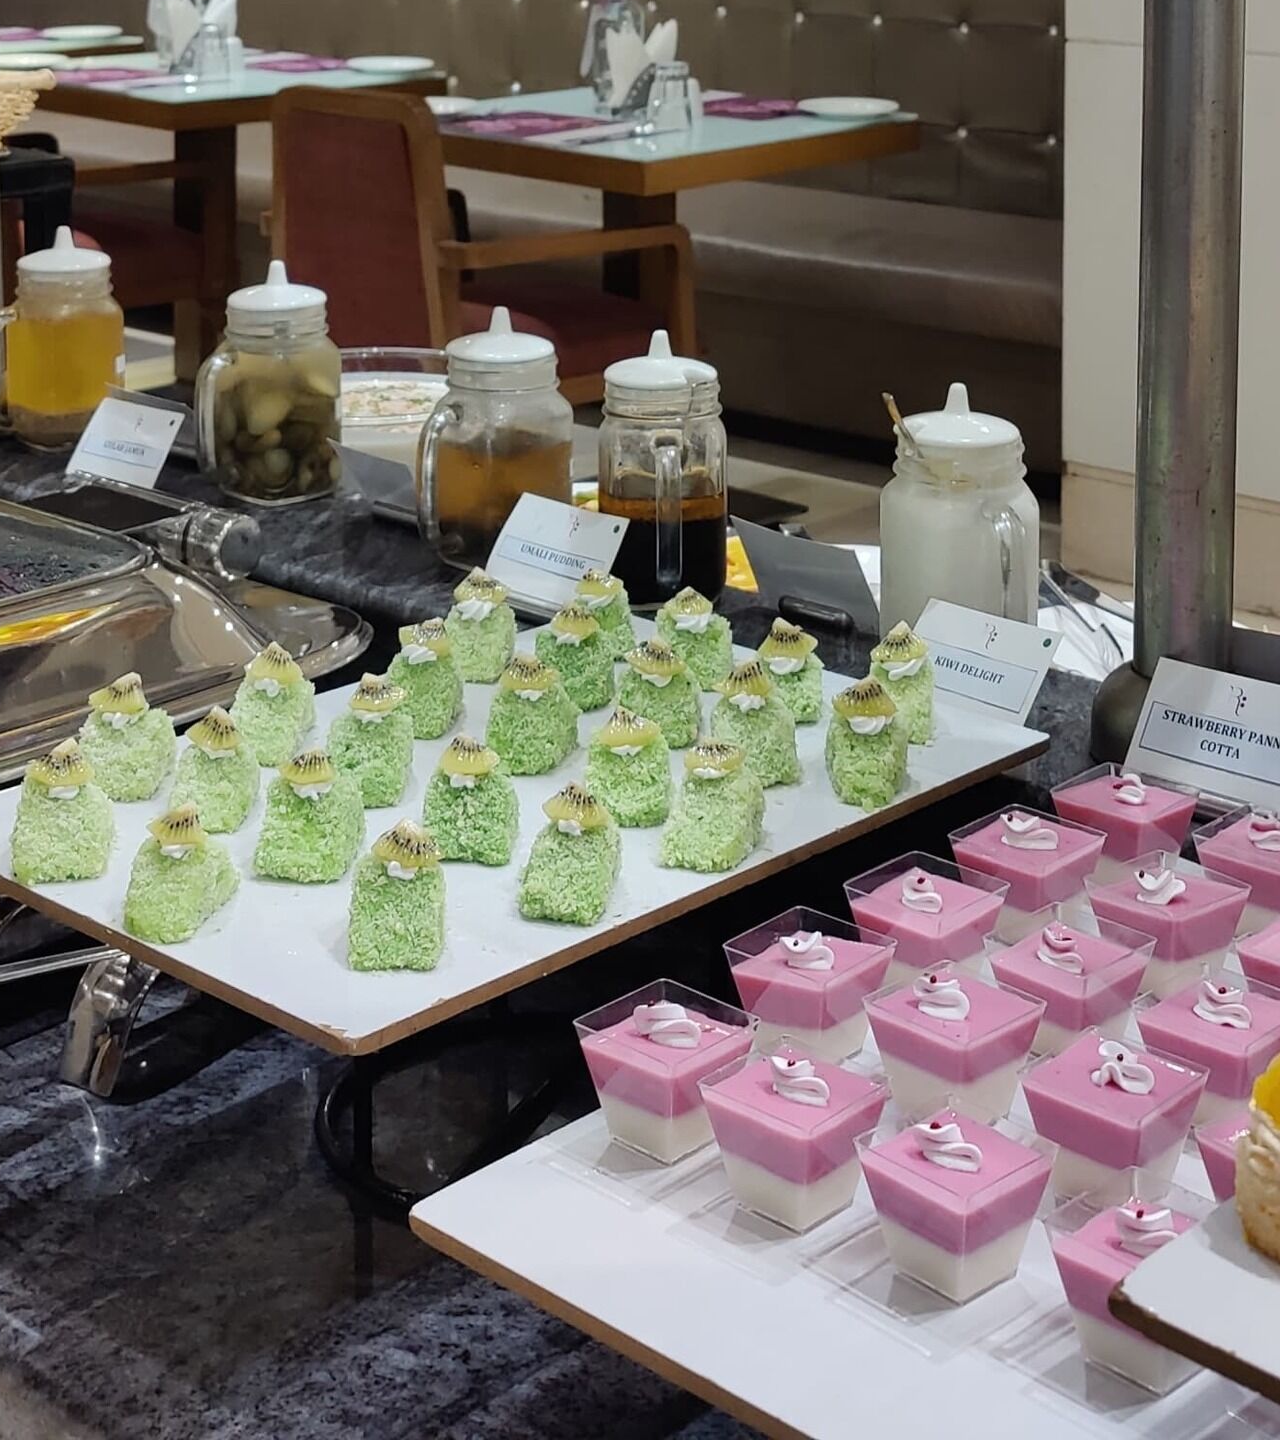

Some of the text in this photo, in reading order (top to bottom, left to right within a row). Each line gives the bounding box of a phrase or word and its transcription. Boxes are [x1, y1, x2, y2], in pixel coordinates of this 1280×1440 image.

[521, 543, 586, 569] UMALI PUDDING
[934, 656, 1005, 684] KIWI DELIGHT
[1162, 708, 1247, 741] STRAWBERRY
[1200, 739, 1240, 760] COTTA
